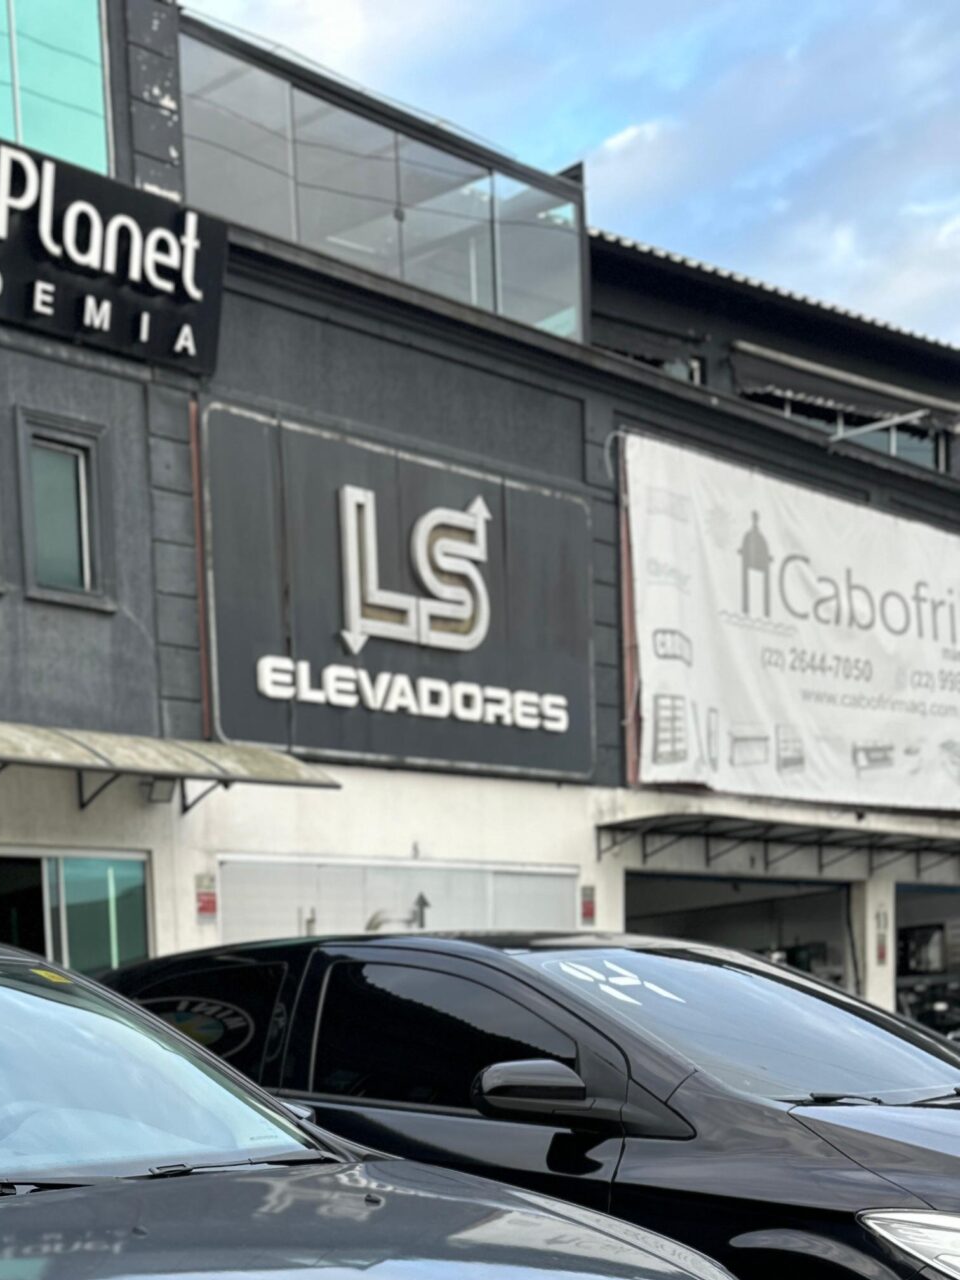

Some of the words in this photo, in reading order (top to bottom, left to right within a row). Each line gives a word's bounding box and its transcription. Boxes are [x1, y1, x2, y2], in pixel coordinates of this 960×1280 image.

[341, 484, 492, 655] LS
[257, 654, 570, 733] ELEVADORES
[789, 648, 874, 683] 2644-7050
